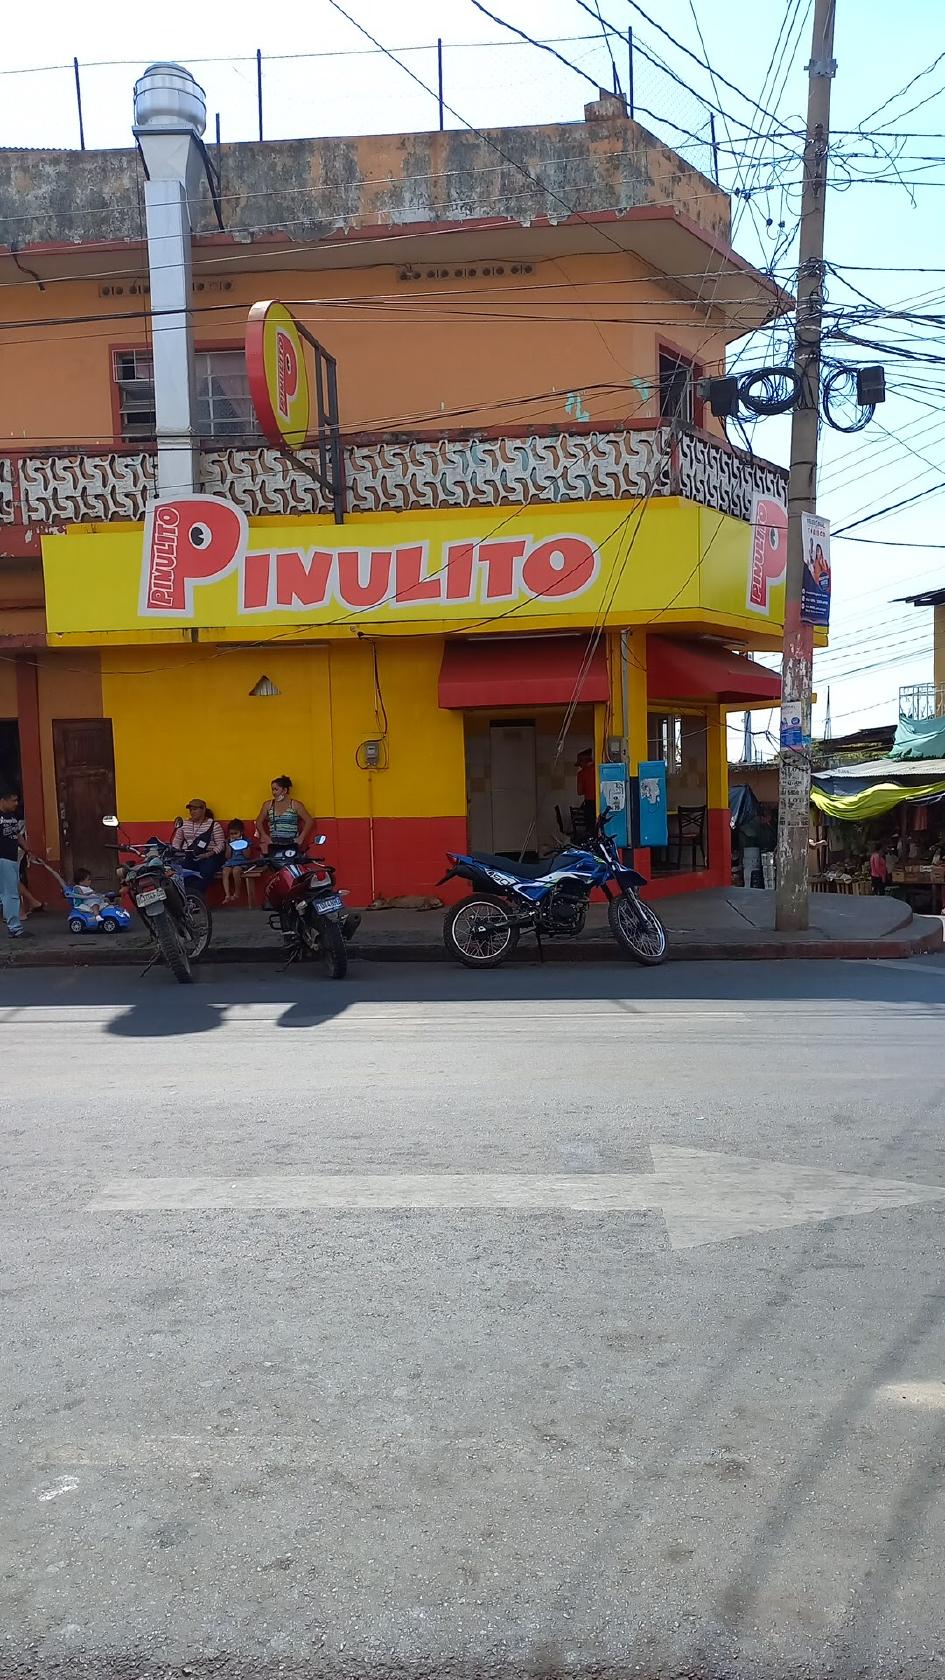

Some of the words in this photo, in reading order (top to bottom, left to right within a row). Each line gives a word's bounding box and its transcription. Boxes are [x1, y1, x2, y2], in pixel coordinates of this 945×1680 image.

[146, 500, 595, 609] PINULITO
[150, 506, 181, 607] PINULITO
[751, 502, 768, 602] PINULITO
